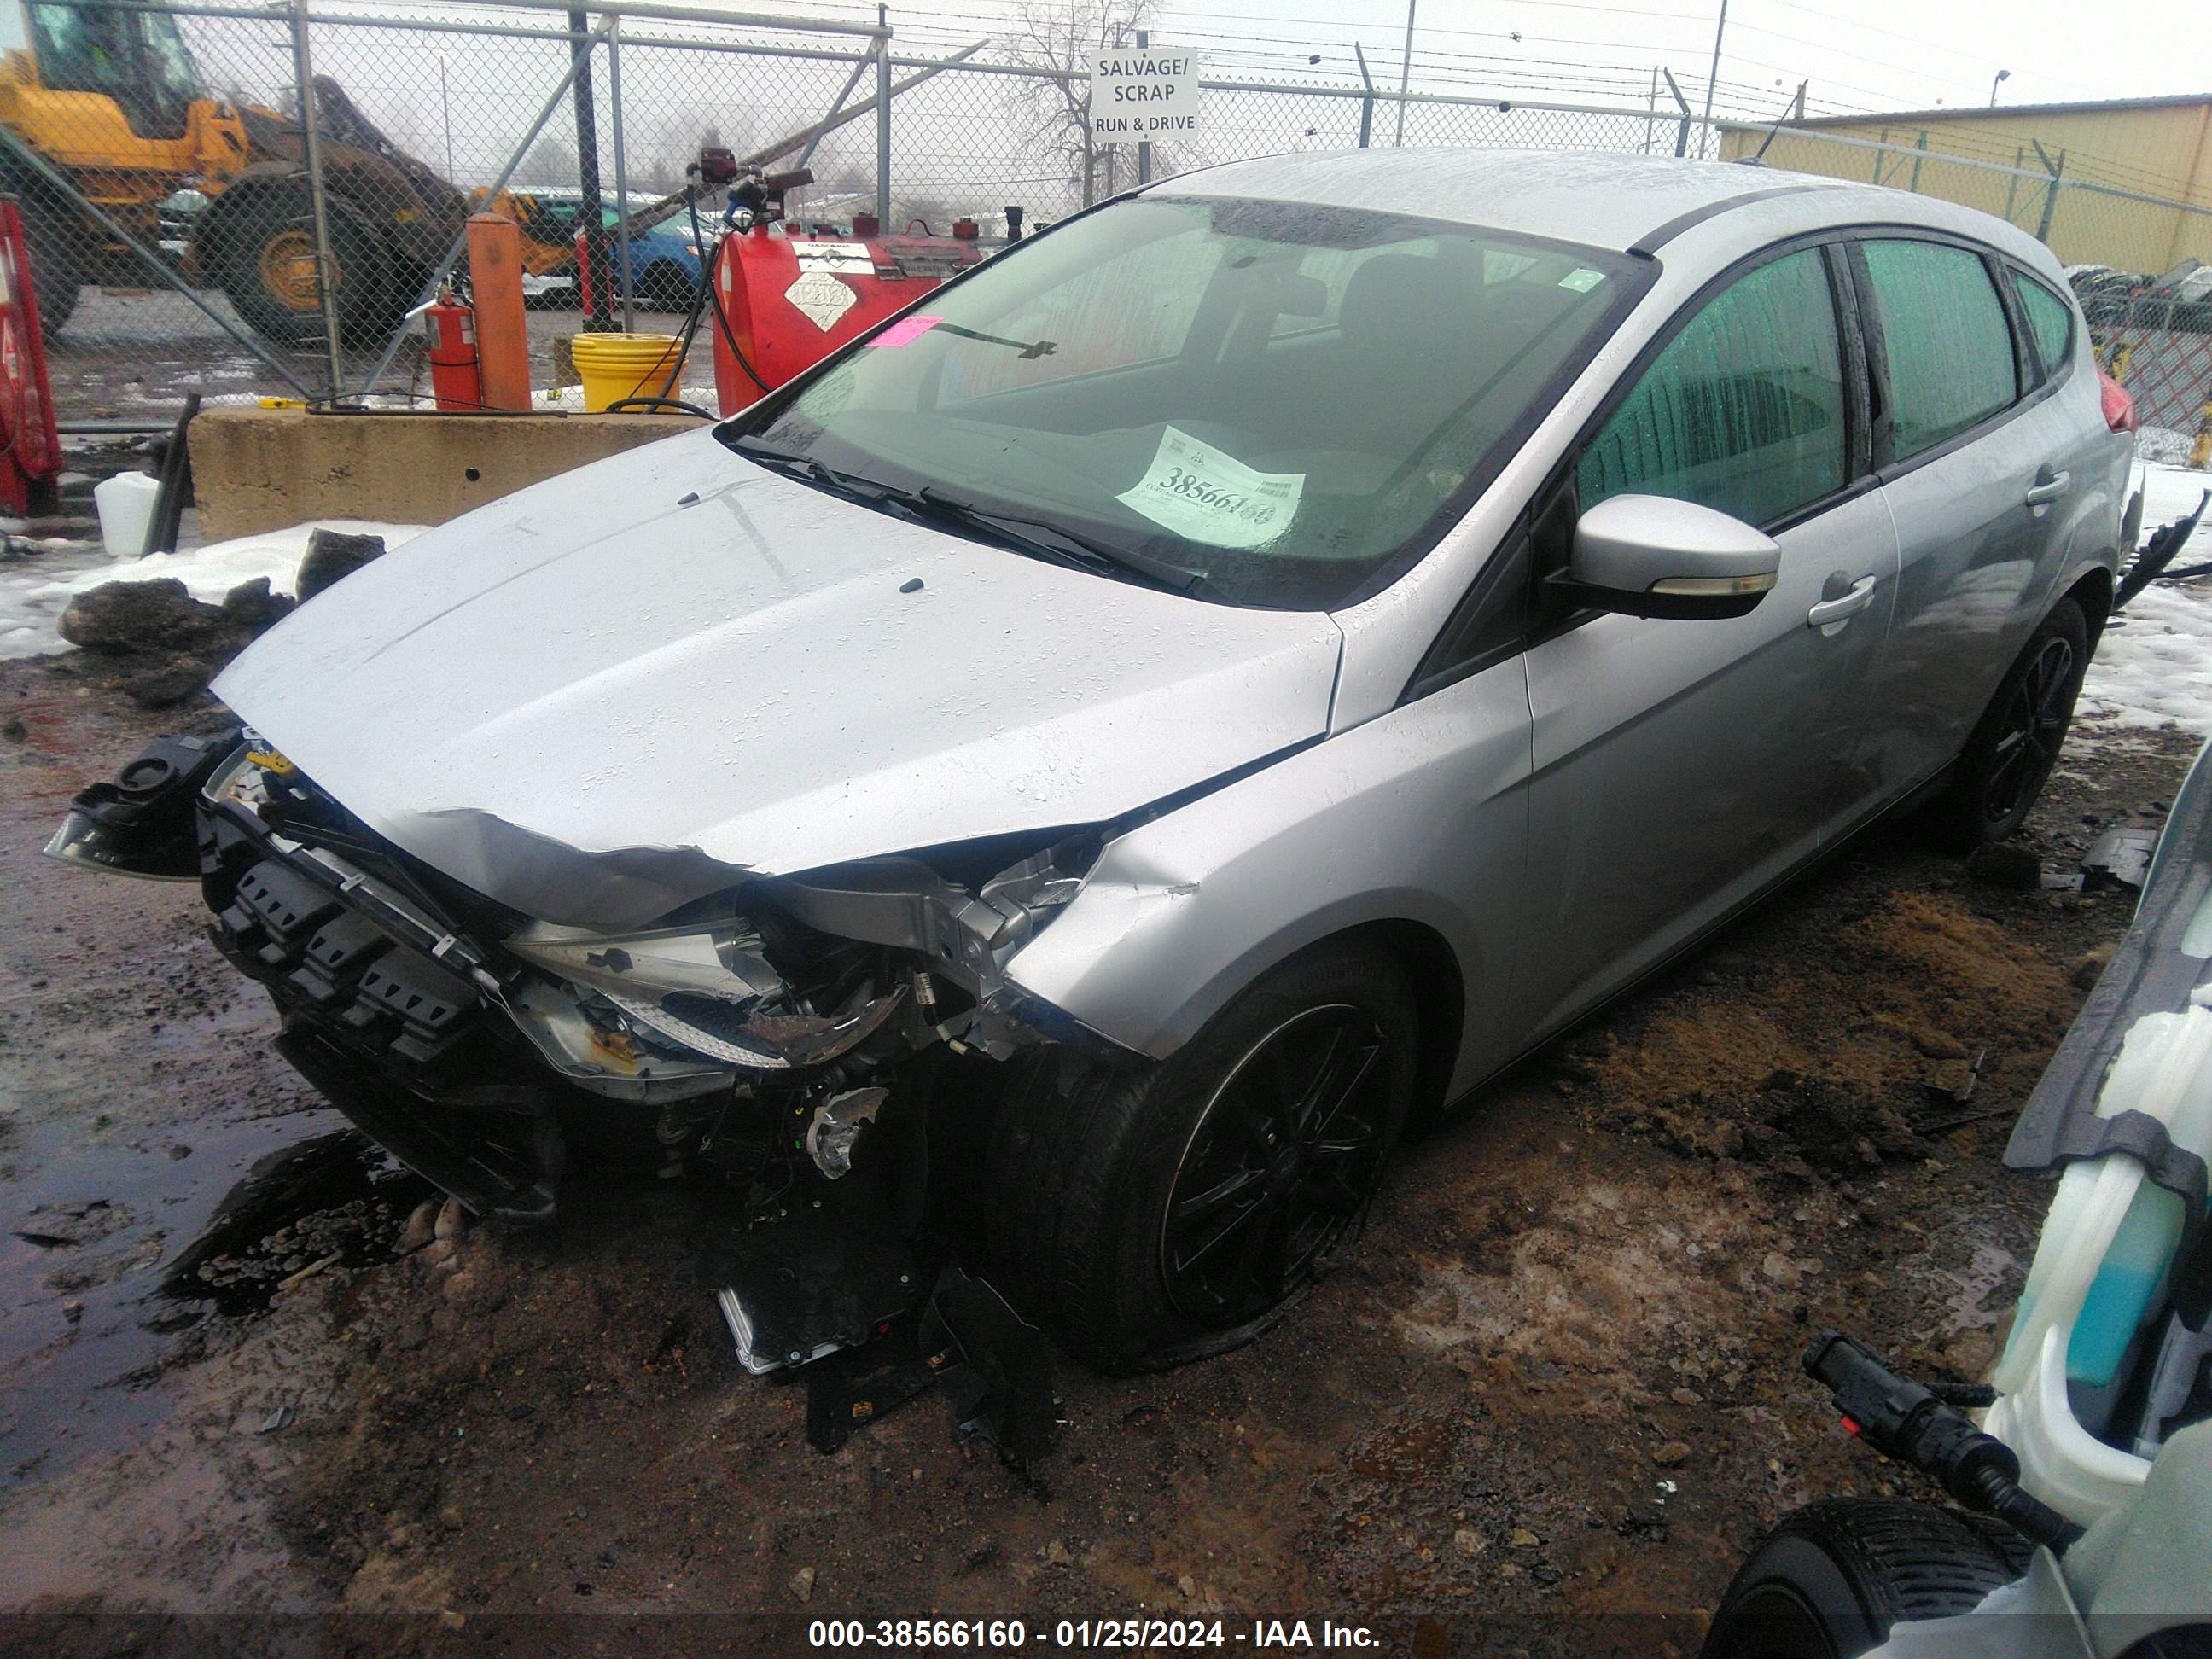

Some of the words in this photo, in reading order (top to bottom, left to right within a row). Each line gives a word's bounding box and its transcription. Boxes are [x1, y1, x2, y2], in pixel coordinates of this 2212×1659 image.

[1099, 58, 1188, 76] SALVAGE/
[1115, 84, 1175, 102] SCRAP
[1096, 118, 1127, 131] RUN
[1133, 117, 1144, 131] &
[1149, 116, 1195, 130] DRIVE
